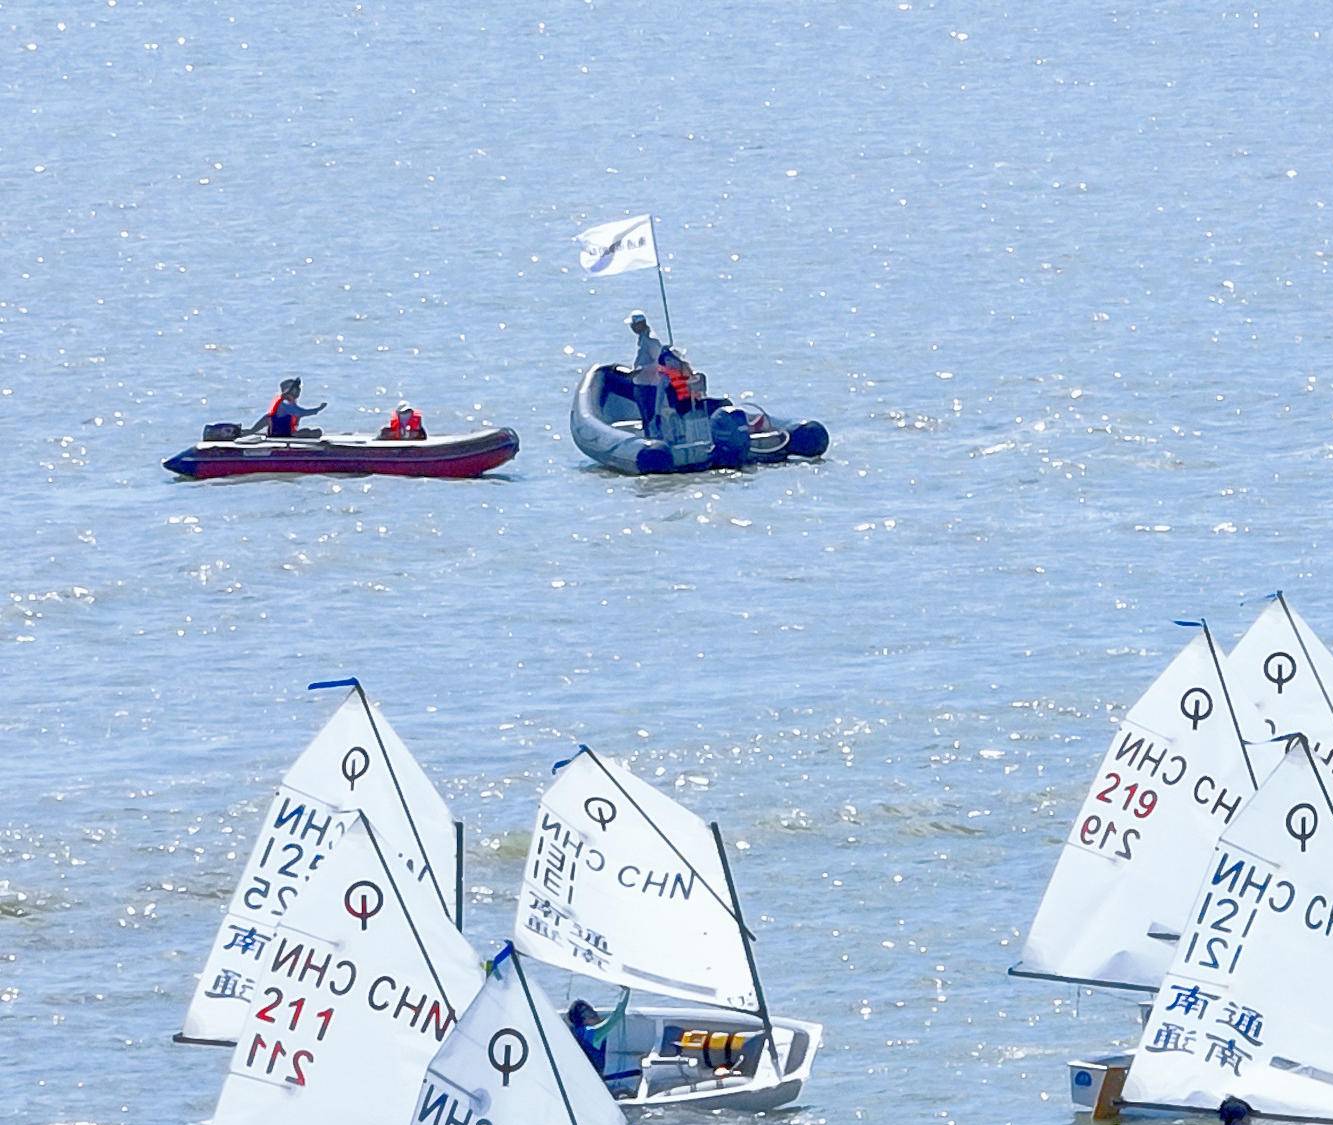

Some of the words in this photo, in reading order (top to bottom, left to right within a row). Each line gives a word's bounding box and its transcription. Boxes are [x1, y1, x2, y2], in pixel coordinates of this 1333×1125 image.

[1096, 773, 1158, 818] 219
[1194, 776, 1242, 824] CH
[618, 866, 695, 900] CHN
[1197, 892, 1257, 938] 121
[223, 924, 272, 960] 南
[256, 987, 334, 1041] 211
[368, 976, 453, 1042] CHN
[1166, 985, 1264, 1046] 南通
